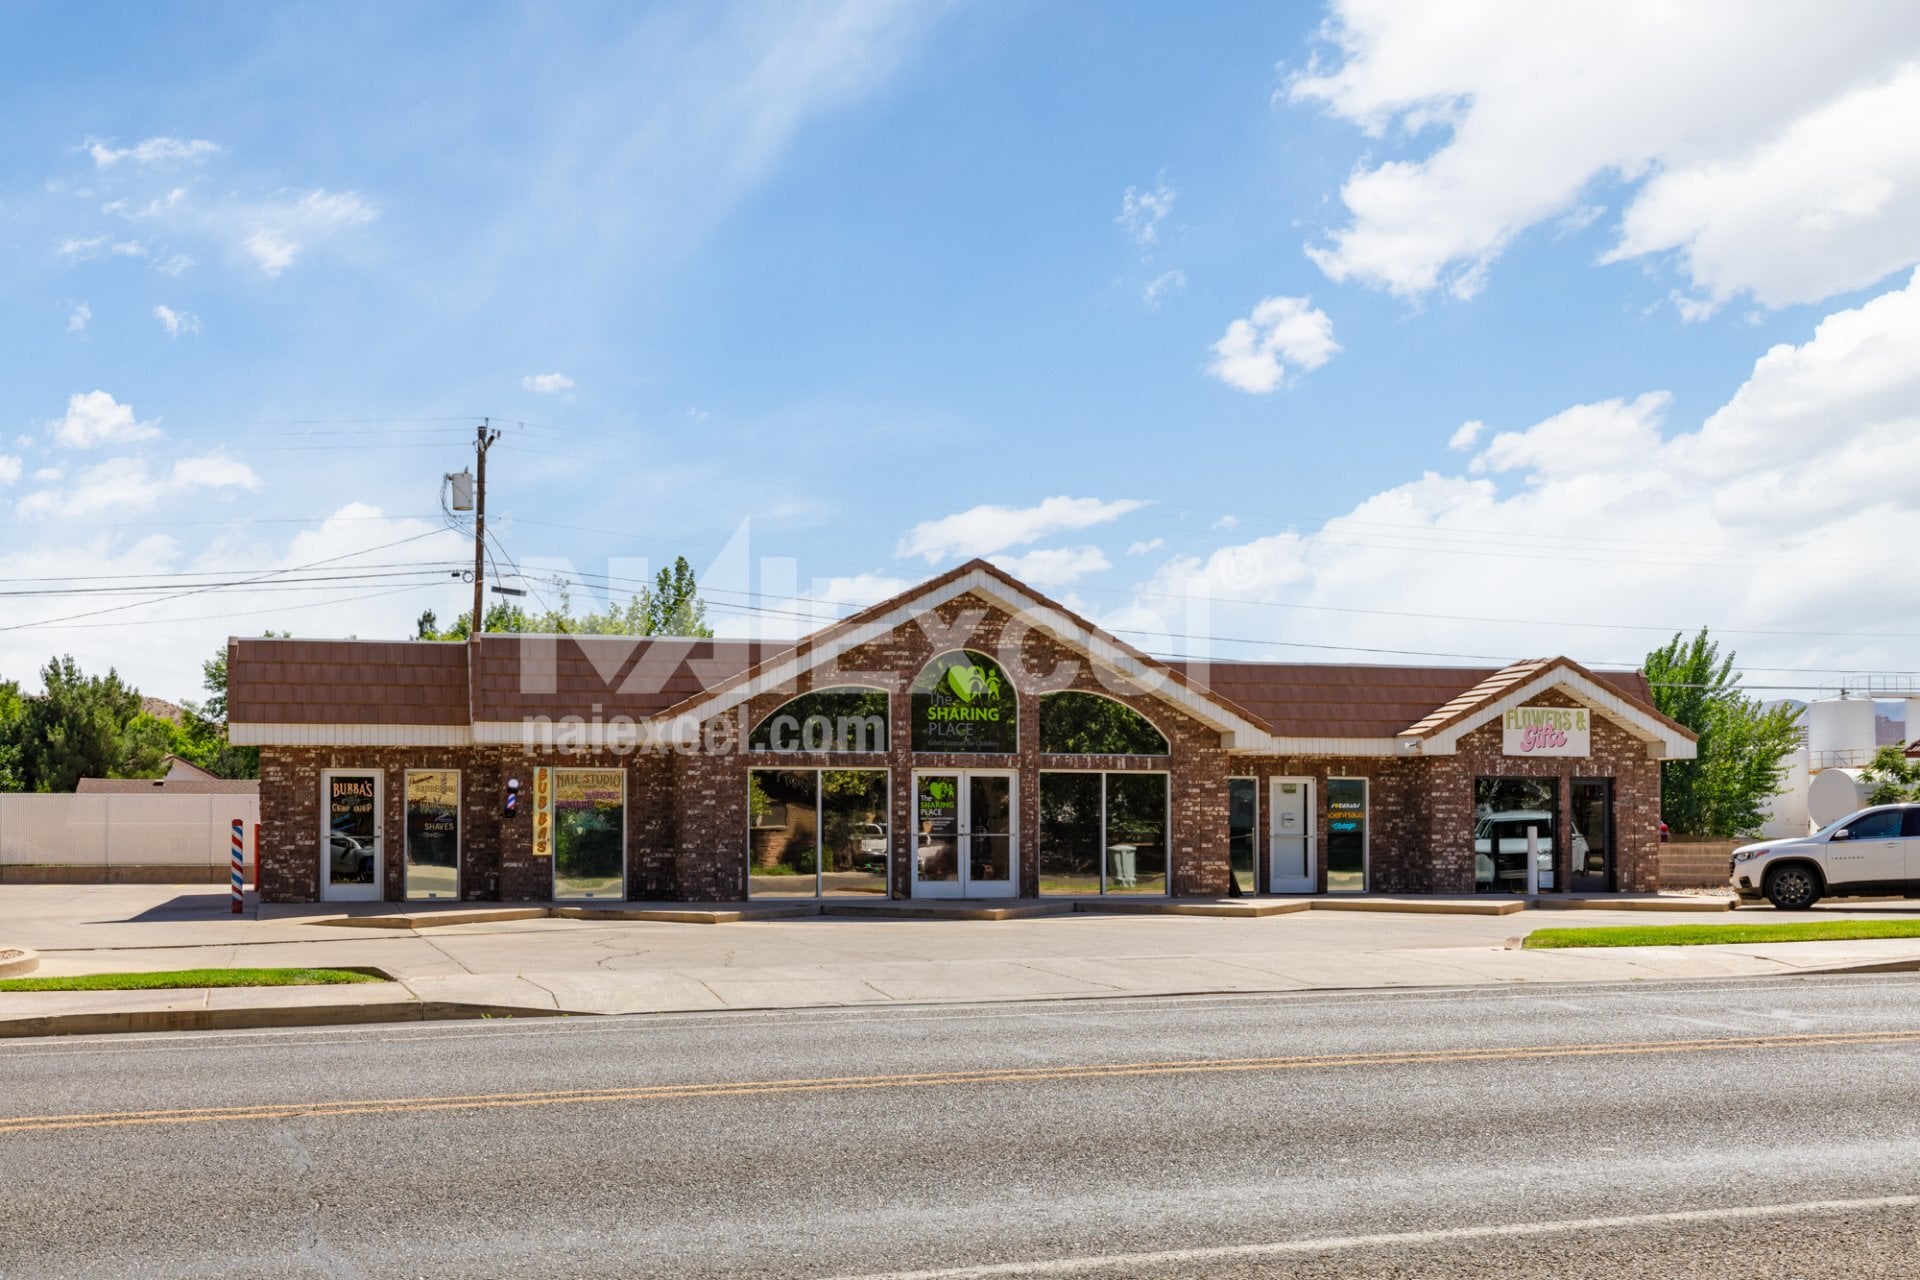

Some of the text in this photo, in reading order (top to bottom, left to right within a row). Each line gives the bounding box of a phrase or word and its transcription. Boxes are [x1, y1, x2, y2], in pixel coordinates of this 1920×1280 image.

[928, 692, 953, 706] The
[927, 707, 999, 721] SHARING
[1505, 709, 1587, 731] FLOWERS &
[928, 722, 974, 736] PLACE
[1519, 723, 1568, 753] Gifts
[556, 774, 620, 788] NAIL STUDIO
[333, 781, 373, 798] BUBBA'S
[920, 794, 934, 802] The
[920, 801, 955, 809] SHARING
[537, 768, 550, 853] BUBBA'S
[920, 808, 942, 816] PLACE
[424, 822, 455, 832] SHAVES
